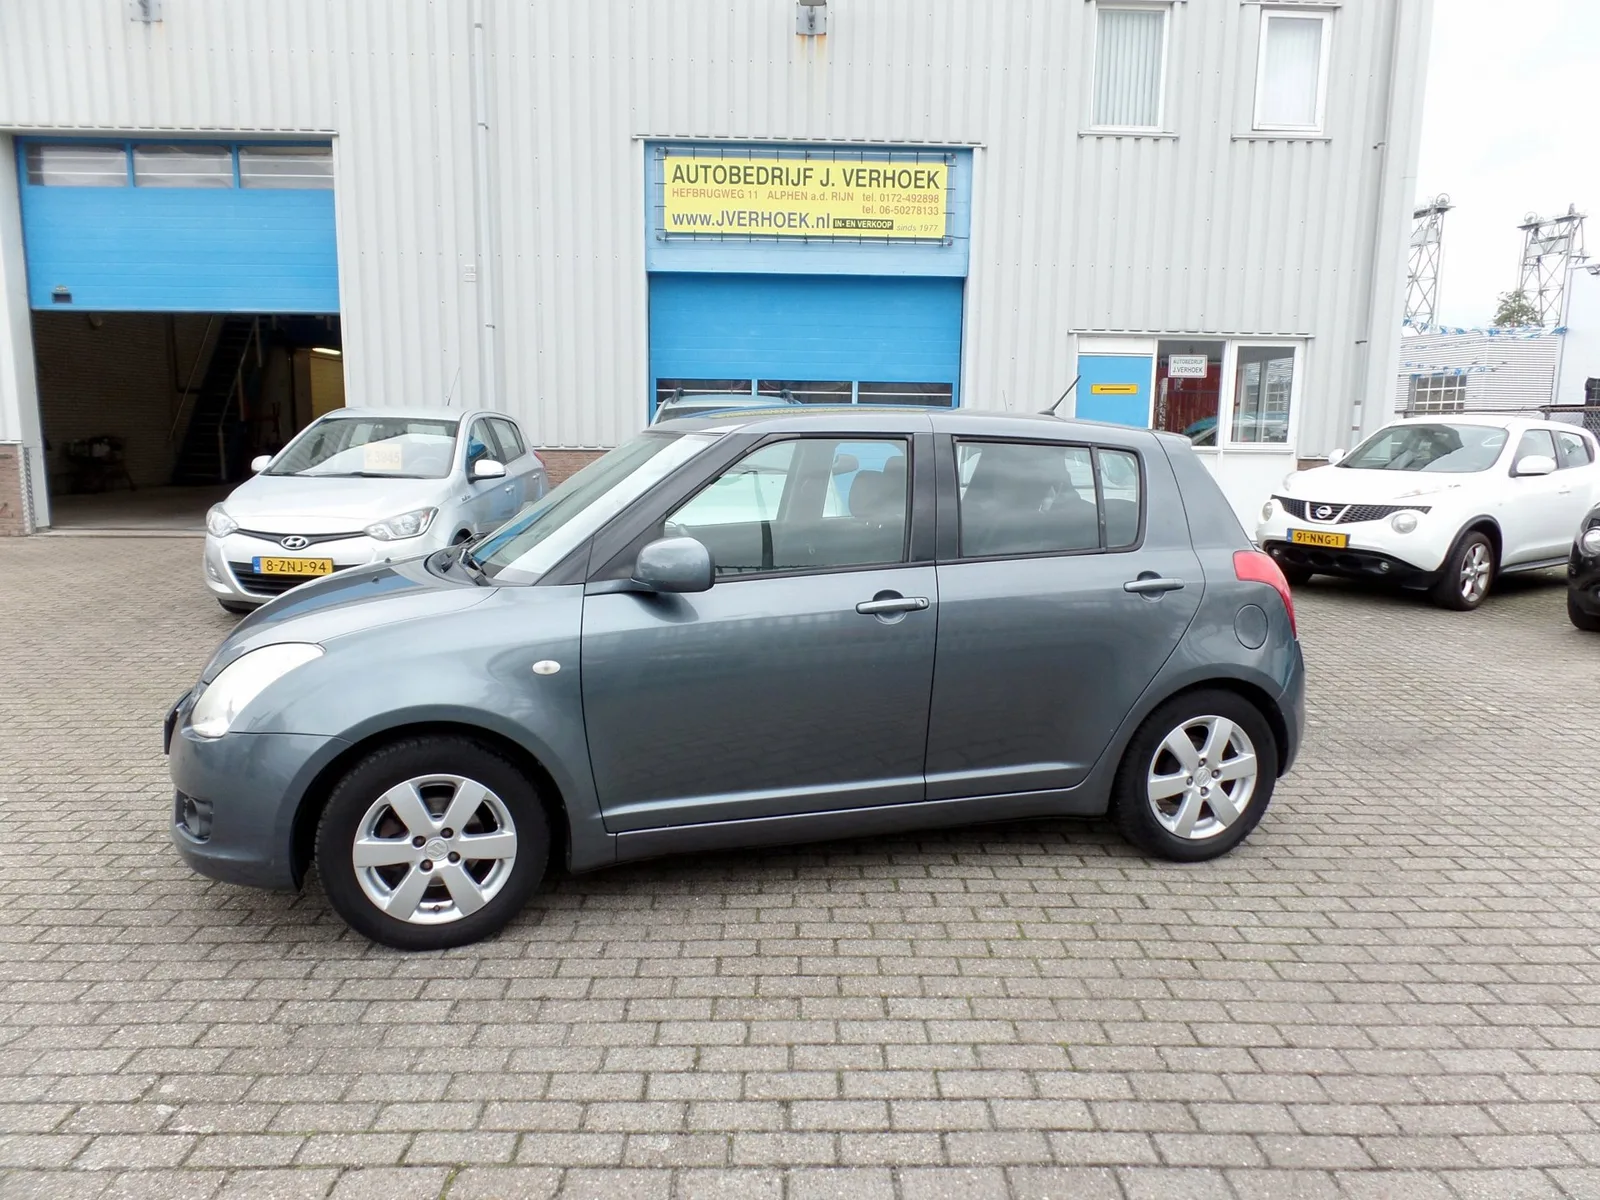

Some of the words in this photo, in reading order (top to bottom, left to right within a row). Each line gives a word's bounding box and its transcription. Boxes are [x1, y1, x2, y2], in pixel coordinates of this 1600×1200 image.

[672, 164, 814, 187] AUTOBEDRIJF
[820, 168, 835, 187] J.
[842, 168, 940, 189] VERHOEK
[672, 188, 744, 199] HEFBRUGWEG
[748, 190, 758, 199] 11
[767, 190, 808, 200] ALPHEN
[810, 191, 828, 201] a.d.
[831, 191, 854, 201] RIJN
[862, 192, 877, 202] tel.
[879, 193, 940, 203] 0172-492898
[862, 204, 877, 214] tel.
[879, 205, 939, 215] 06-50278133
[672, 210, 830, 229] www.JVERHOEK.nl
[834, 219, 845, 227] IN-
[846, 219, 857, 228] EN
[858, 220, 893, 229] VERKOOP
[896, 224, 917, 232] sinds
[919, 224, 939, 232] 1977
[1296, 532, 1339, 545] 91-NNG-1
[266, 560, 327, 573] 8-ZNJ-94
